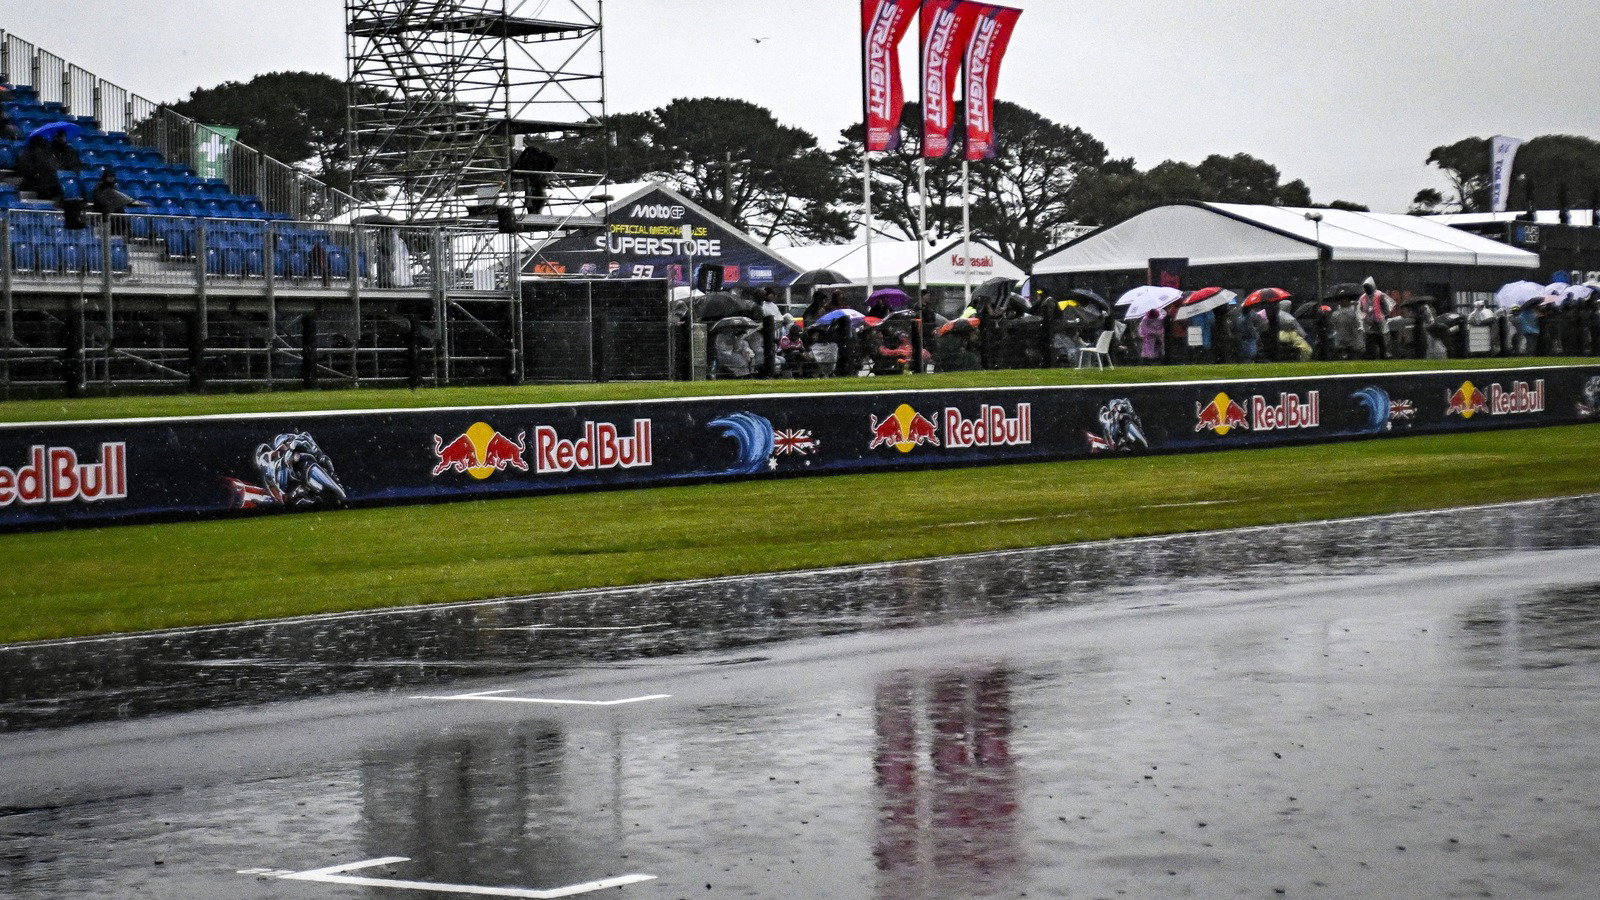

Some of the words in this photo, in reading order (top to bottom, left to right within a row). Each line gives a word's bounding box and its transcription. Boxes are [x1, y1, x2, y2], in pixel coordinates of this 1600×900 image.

[870, 2, 898, 119] STRAIGHT
[927, 10, 957, 128] STRAIGHT
[970, 16, 997, 132] STRAIGHT
[610, 224, 648, 235] OFFICIAL
[650, 225, 708, 236] MERCHAISE
[631, 203, 685, 219] MotoGP
[596, 236, 721, 256] SUPERSTORE
[951, 254, 993, 267] Kaasaki
[632, 264, 655, 279] 93
[1252, 393, 1287, 430] Red
[1288, 390, 1320, 429] Bull
[1490, 381, 1518, 414] Red
[1519, 379, 1544, 412] Bull
[535, 421, 595, 473] Red
[597, 418, 652, 468] Bull
[945, 404, 989, 448] Red
[990, 403, 1031, 445] Bull
[0, 445, 46, 506] ed
[48, 442, 127, 501] Bull
